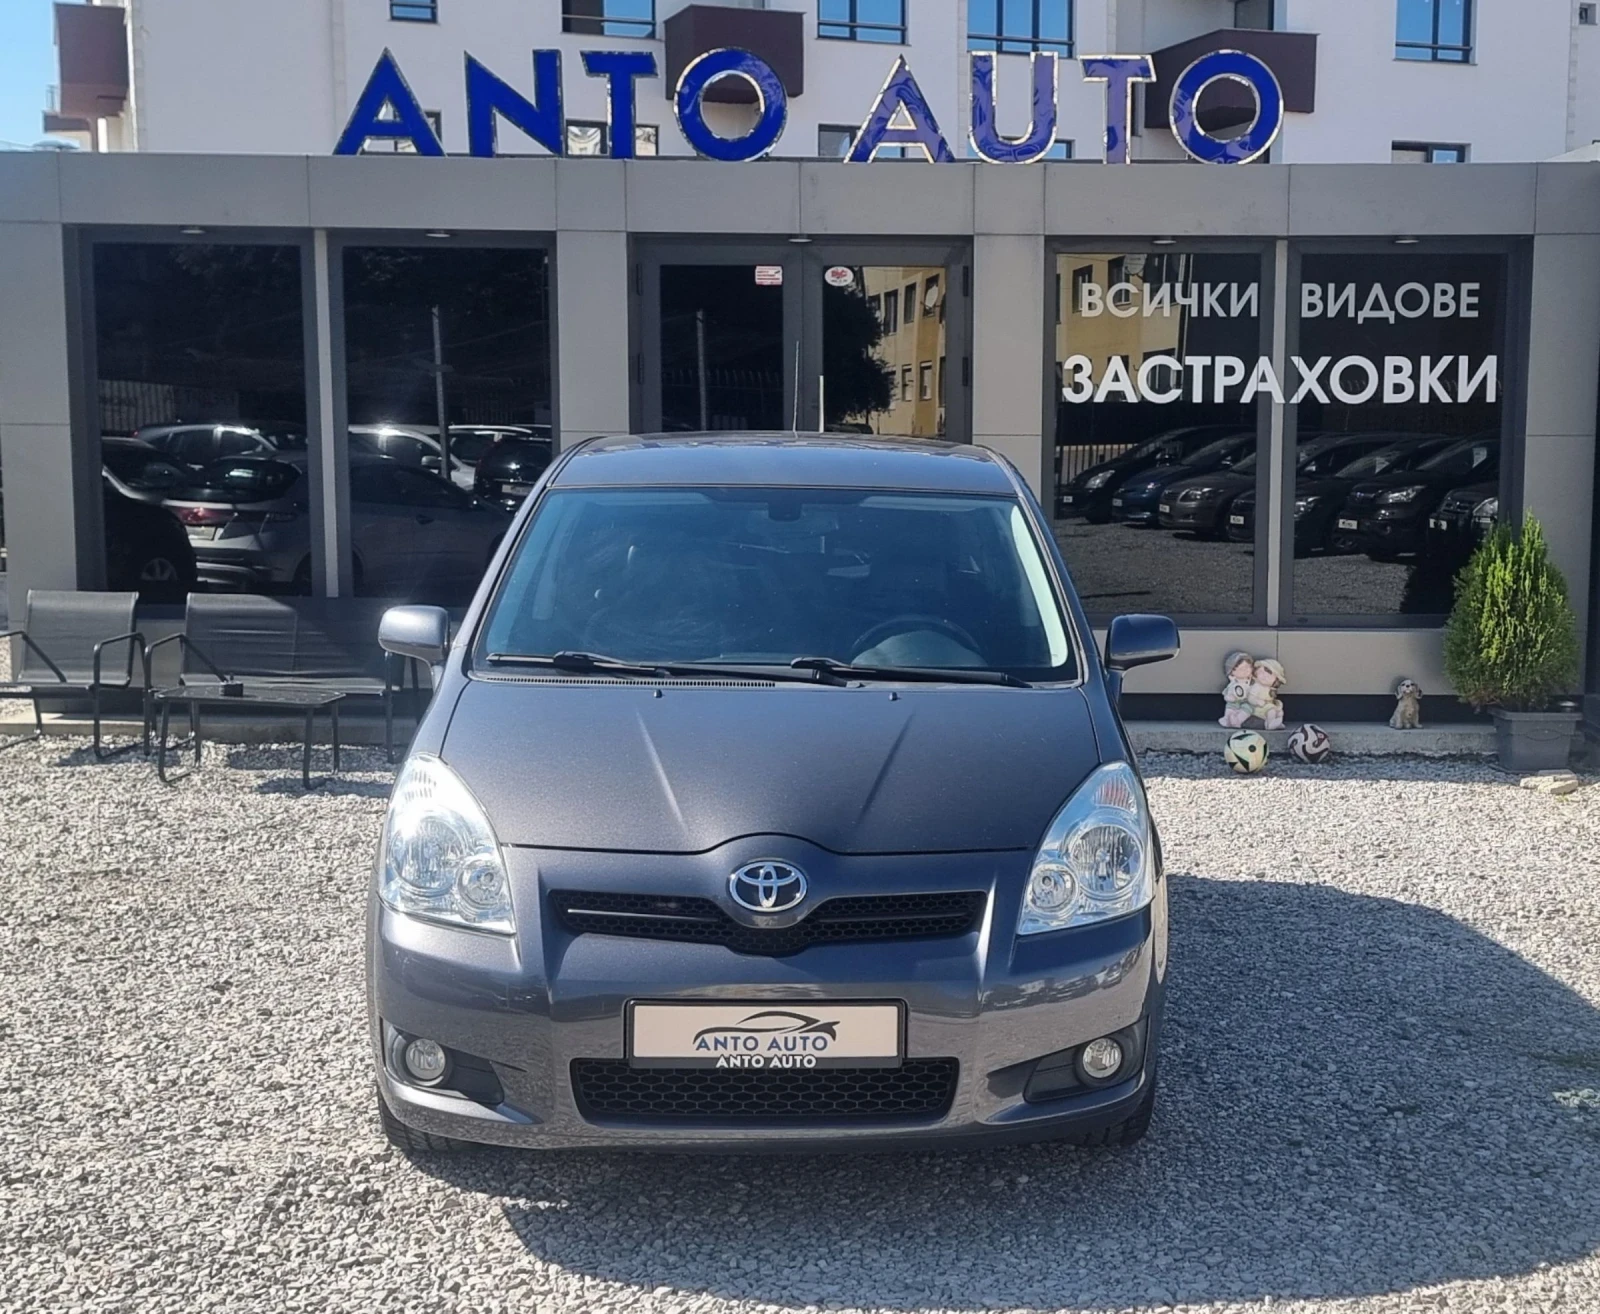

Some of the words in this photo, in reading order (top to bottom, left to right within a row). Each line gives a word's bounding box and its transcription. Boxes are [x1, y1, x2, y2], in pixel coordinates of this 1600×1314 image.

[333, 46, 789, 162] ANTO
[843, 48, 1285, 164] AUTO
[1080, 282, 1259, 318] ВСИЧКИ
[1300, 282, 1481, 324] ВИДОВЕ
[1062, 354, 1498, 404] ЗАСТРАХОВКИ
[695, 1035, 759, 1051] ANTO
[767, 1035, 828, 1051] AUTO
[716, 1054, 765, 1068] ANTO
[770, 1054, 817, 1068] AUTO
